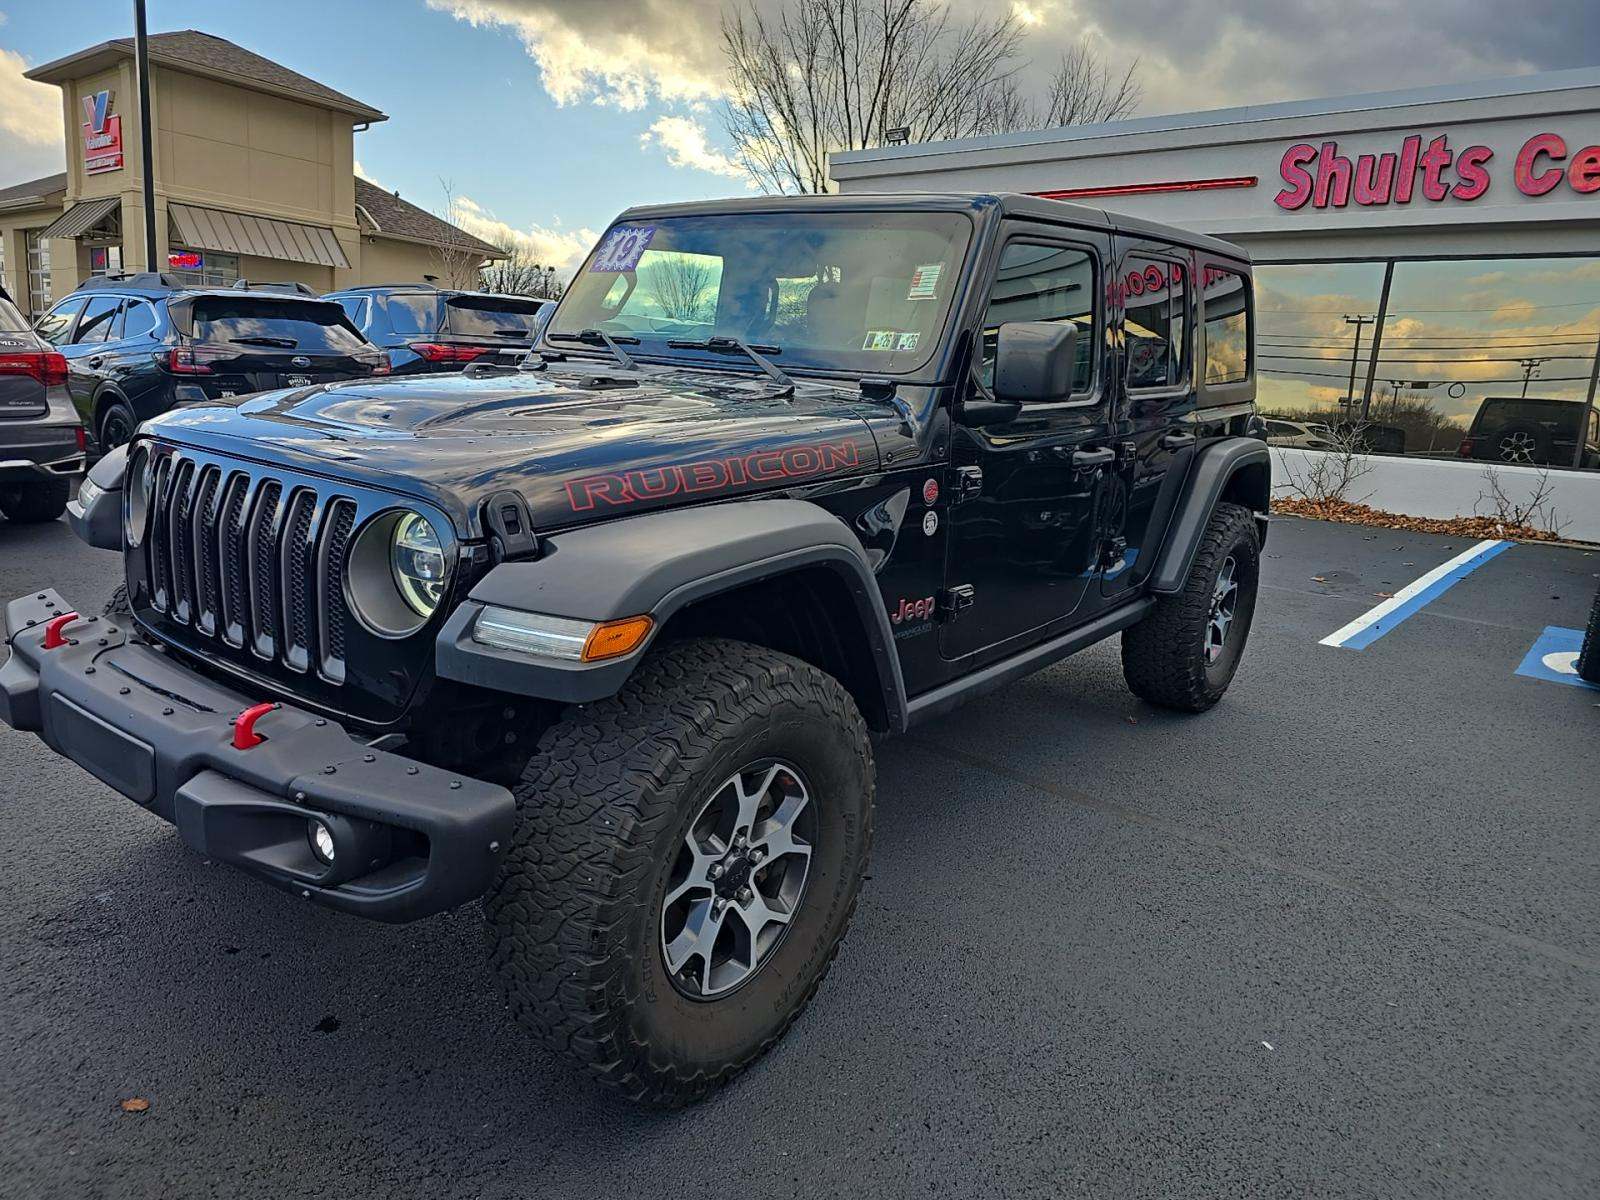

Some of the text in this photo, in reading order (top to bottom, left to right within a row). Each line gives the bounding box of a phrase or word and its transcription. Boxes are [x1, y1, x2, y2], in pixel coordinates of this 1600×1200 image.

[1274, 134, 1494, 210] Shults
[563, 439, 861, 512] RUBICON
[891, 596, 936, 625] Jeep
